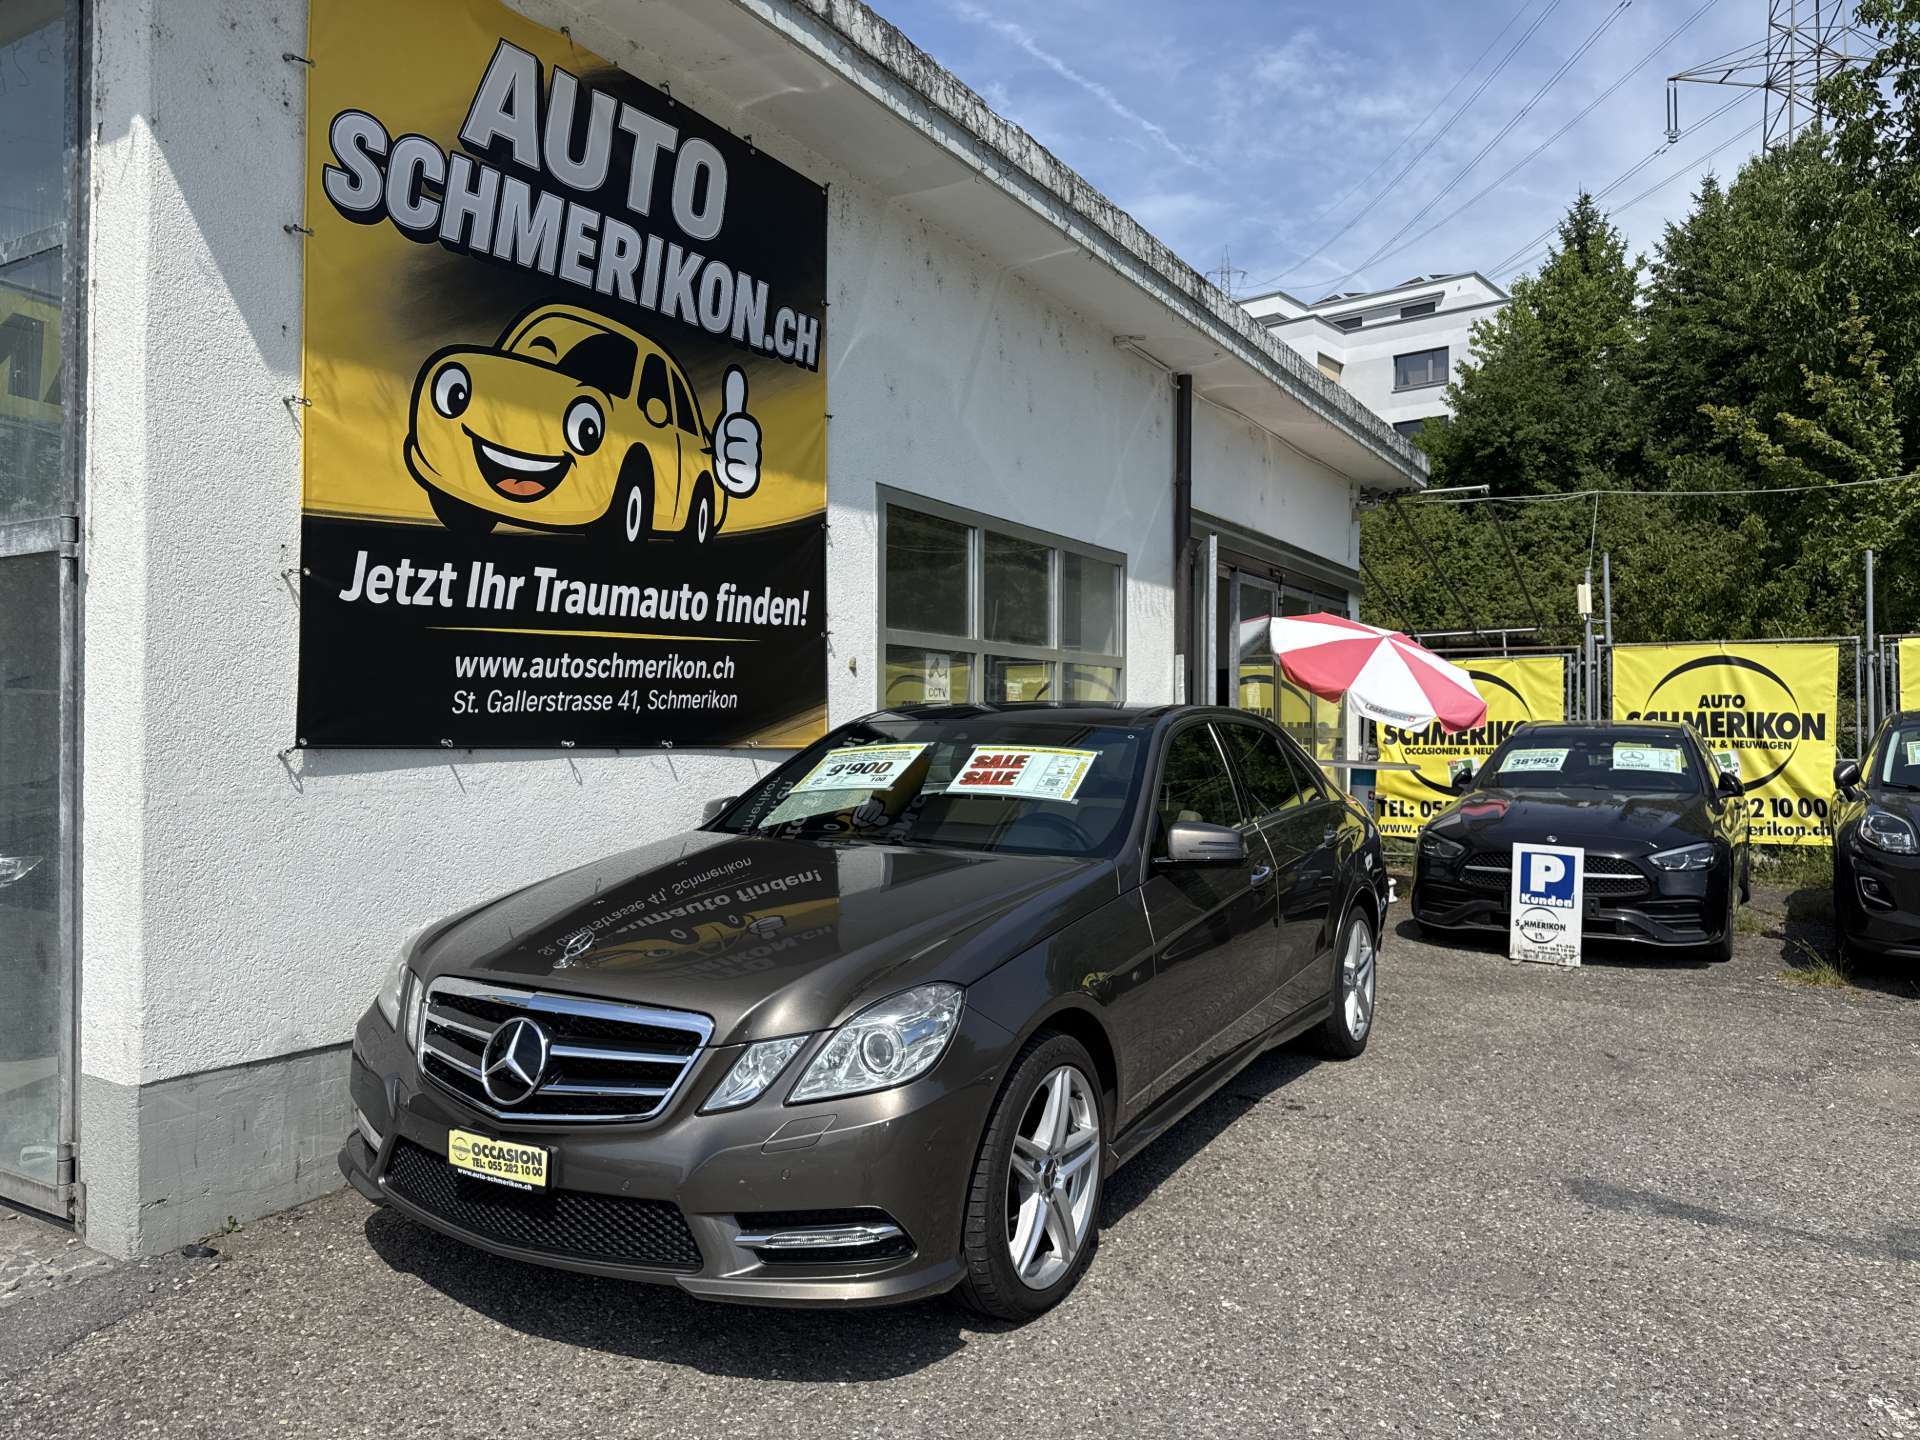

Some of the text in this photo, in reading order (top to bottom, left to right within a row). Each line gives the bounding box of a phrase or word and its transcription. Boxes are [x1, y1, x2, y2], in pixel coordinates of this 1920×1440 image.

[459, 37, 729, 242] AUTO
[324, 110, 820, 369] SCHMERIKON.CH
[339, 550, 809, 627] Jetzt Ihr Traumauto finden!
[455, 652, 735, 680] www.autoschmerikon.ch
[451, 689, 737, 715] St. Gallerstrasse 41, Schmerikon
[928, 688, 947, 698] CCTV
[1698, 694, 1746, 710] AUTO
[1383, 720, 1527, 746] SCHMERIK
[1404, 747, 1495, 756] OCCASIONEN & NEU
[1731, 740, 1793, 751] NEUWAGEN
[826, 761, 894, 778] 9'900
[970, 754, 1031, 769] SALE
[1512, 756, 1559, 766] 38'950
[959, 770, 1020, 786] SALE
[1378, 799, 1415, 818] TEL:
[1530, 854, 1566, 893] P
[1521, 893, 1573, 907] Kunden
[471, 1142, 543, 1167] OCCASION
[472, 1157, 543, 1178] TEL: 055 282 10 00
[457, 1168, 533, 1191] www.auto-schmerikon.ch
